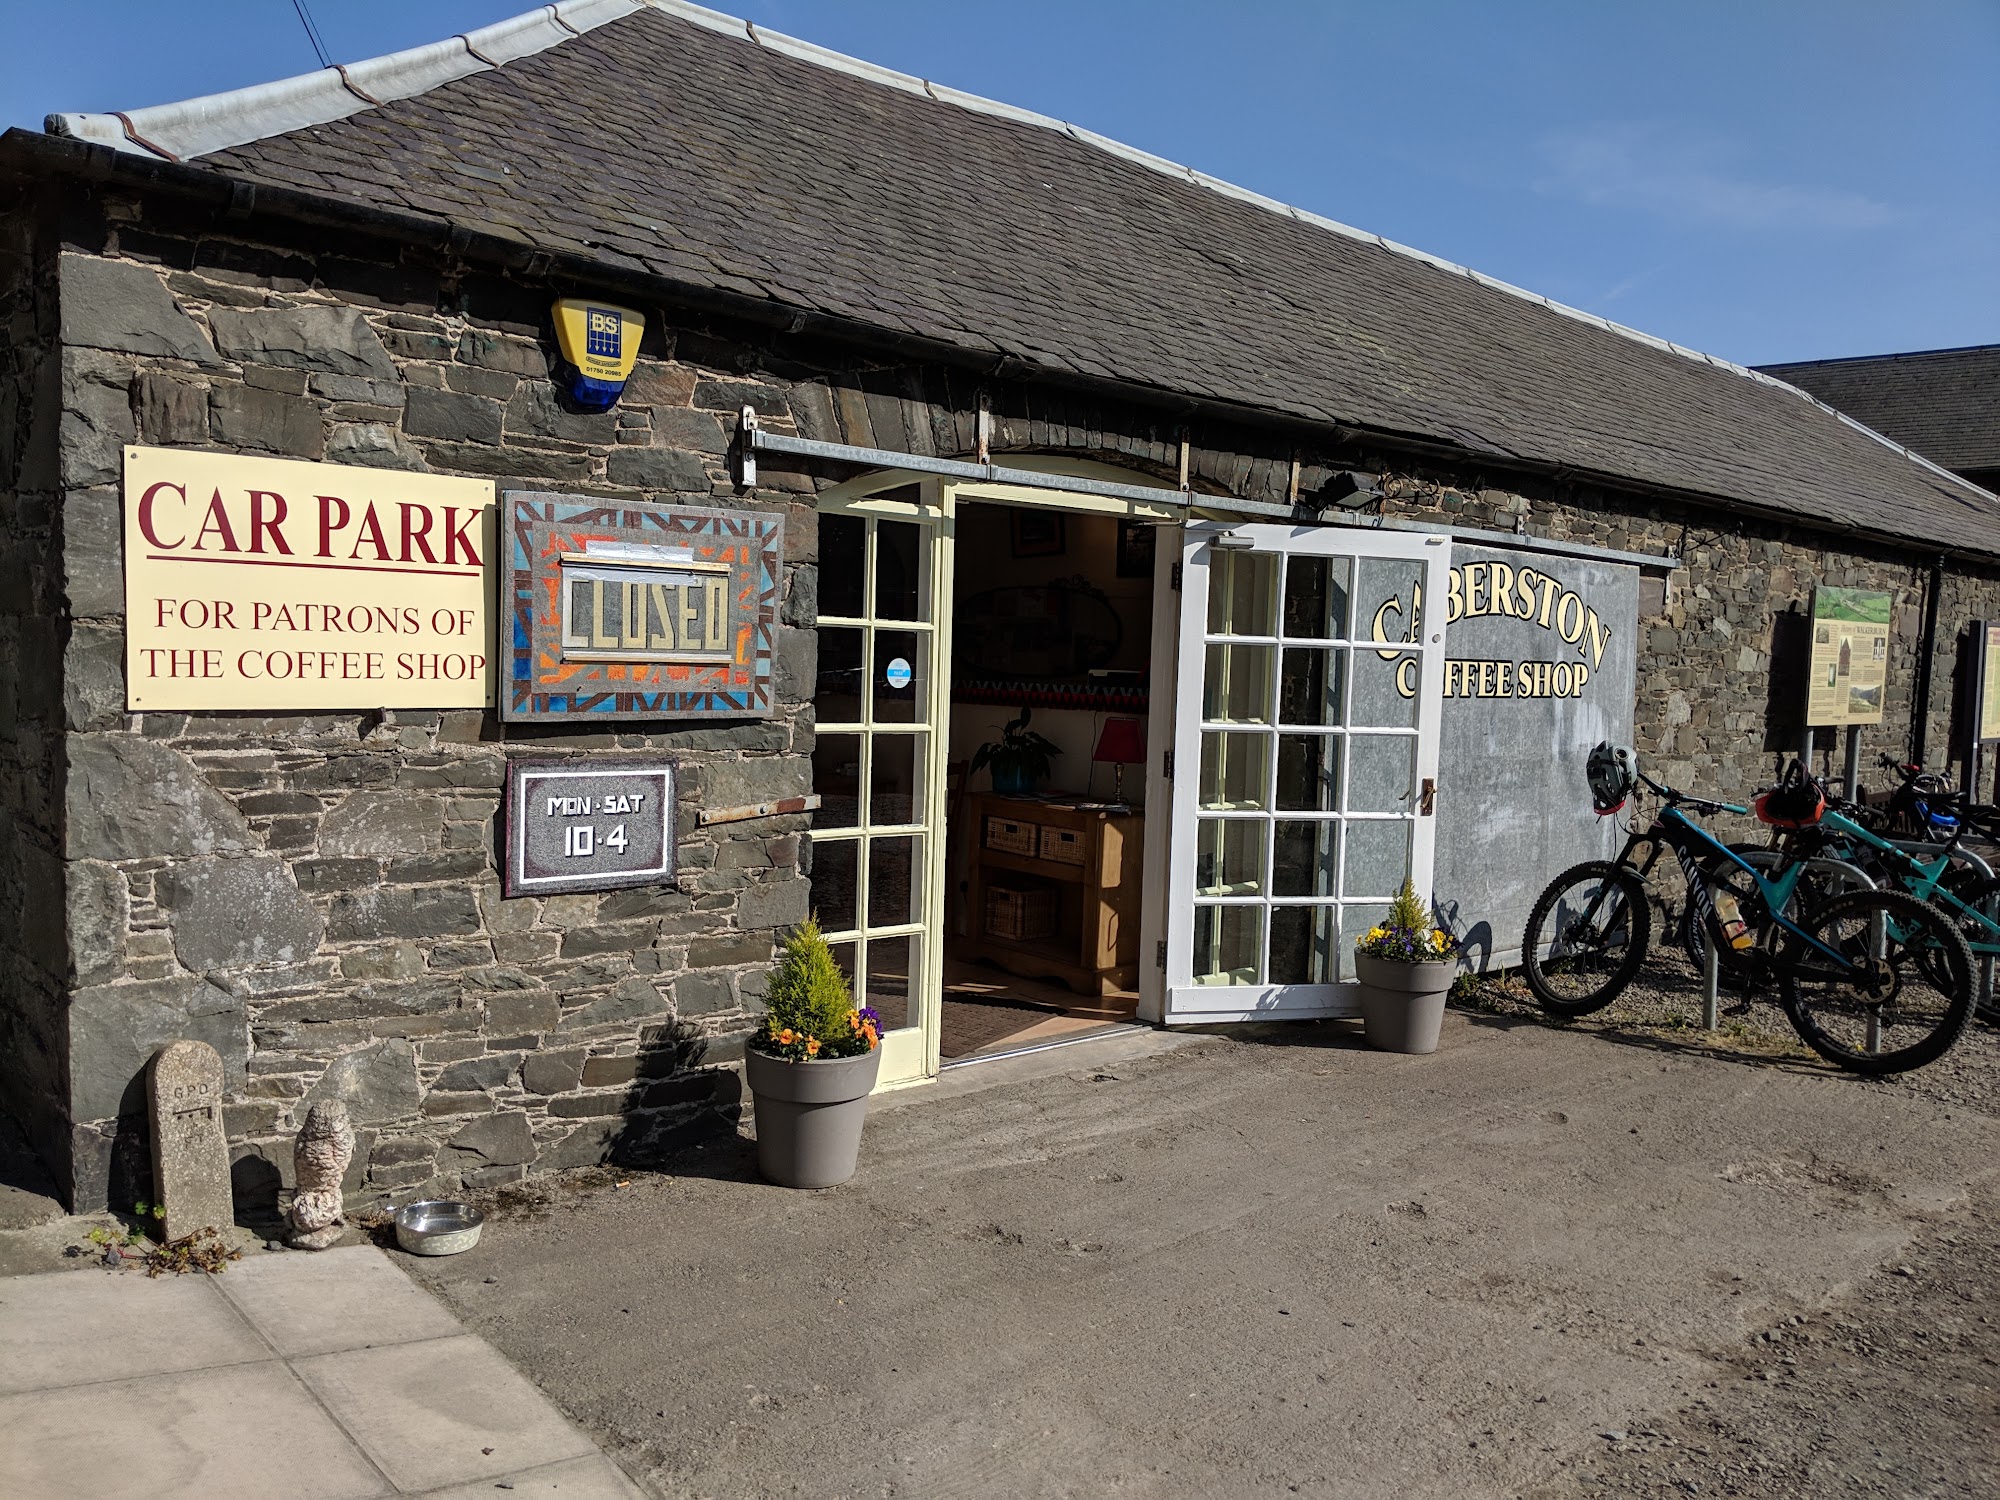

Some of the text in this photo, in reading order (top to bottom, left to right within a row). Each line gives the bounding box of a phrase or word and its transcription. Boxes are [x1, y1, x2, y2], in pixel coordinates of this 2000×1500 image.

[592, 313, 618, 334] BS
[138, 481, 486, 567] CAR PARK
[154, 598, 475, 636] FOR PATRONS OF
[562, 576, 729, 650] CLOSED
[139, 648, 487, 681] THE COFFEE SHOP
[1395, 657, 1589, 699] CFFEE SHOP
[1678, 845, 1713, 920] CANYON
[174, 1083, 208, 1099] GPO
